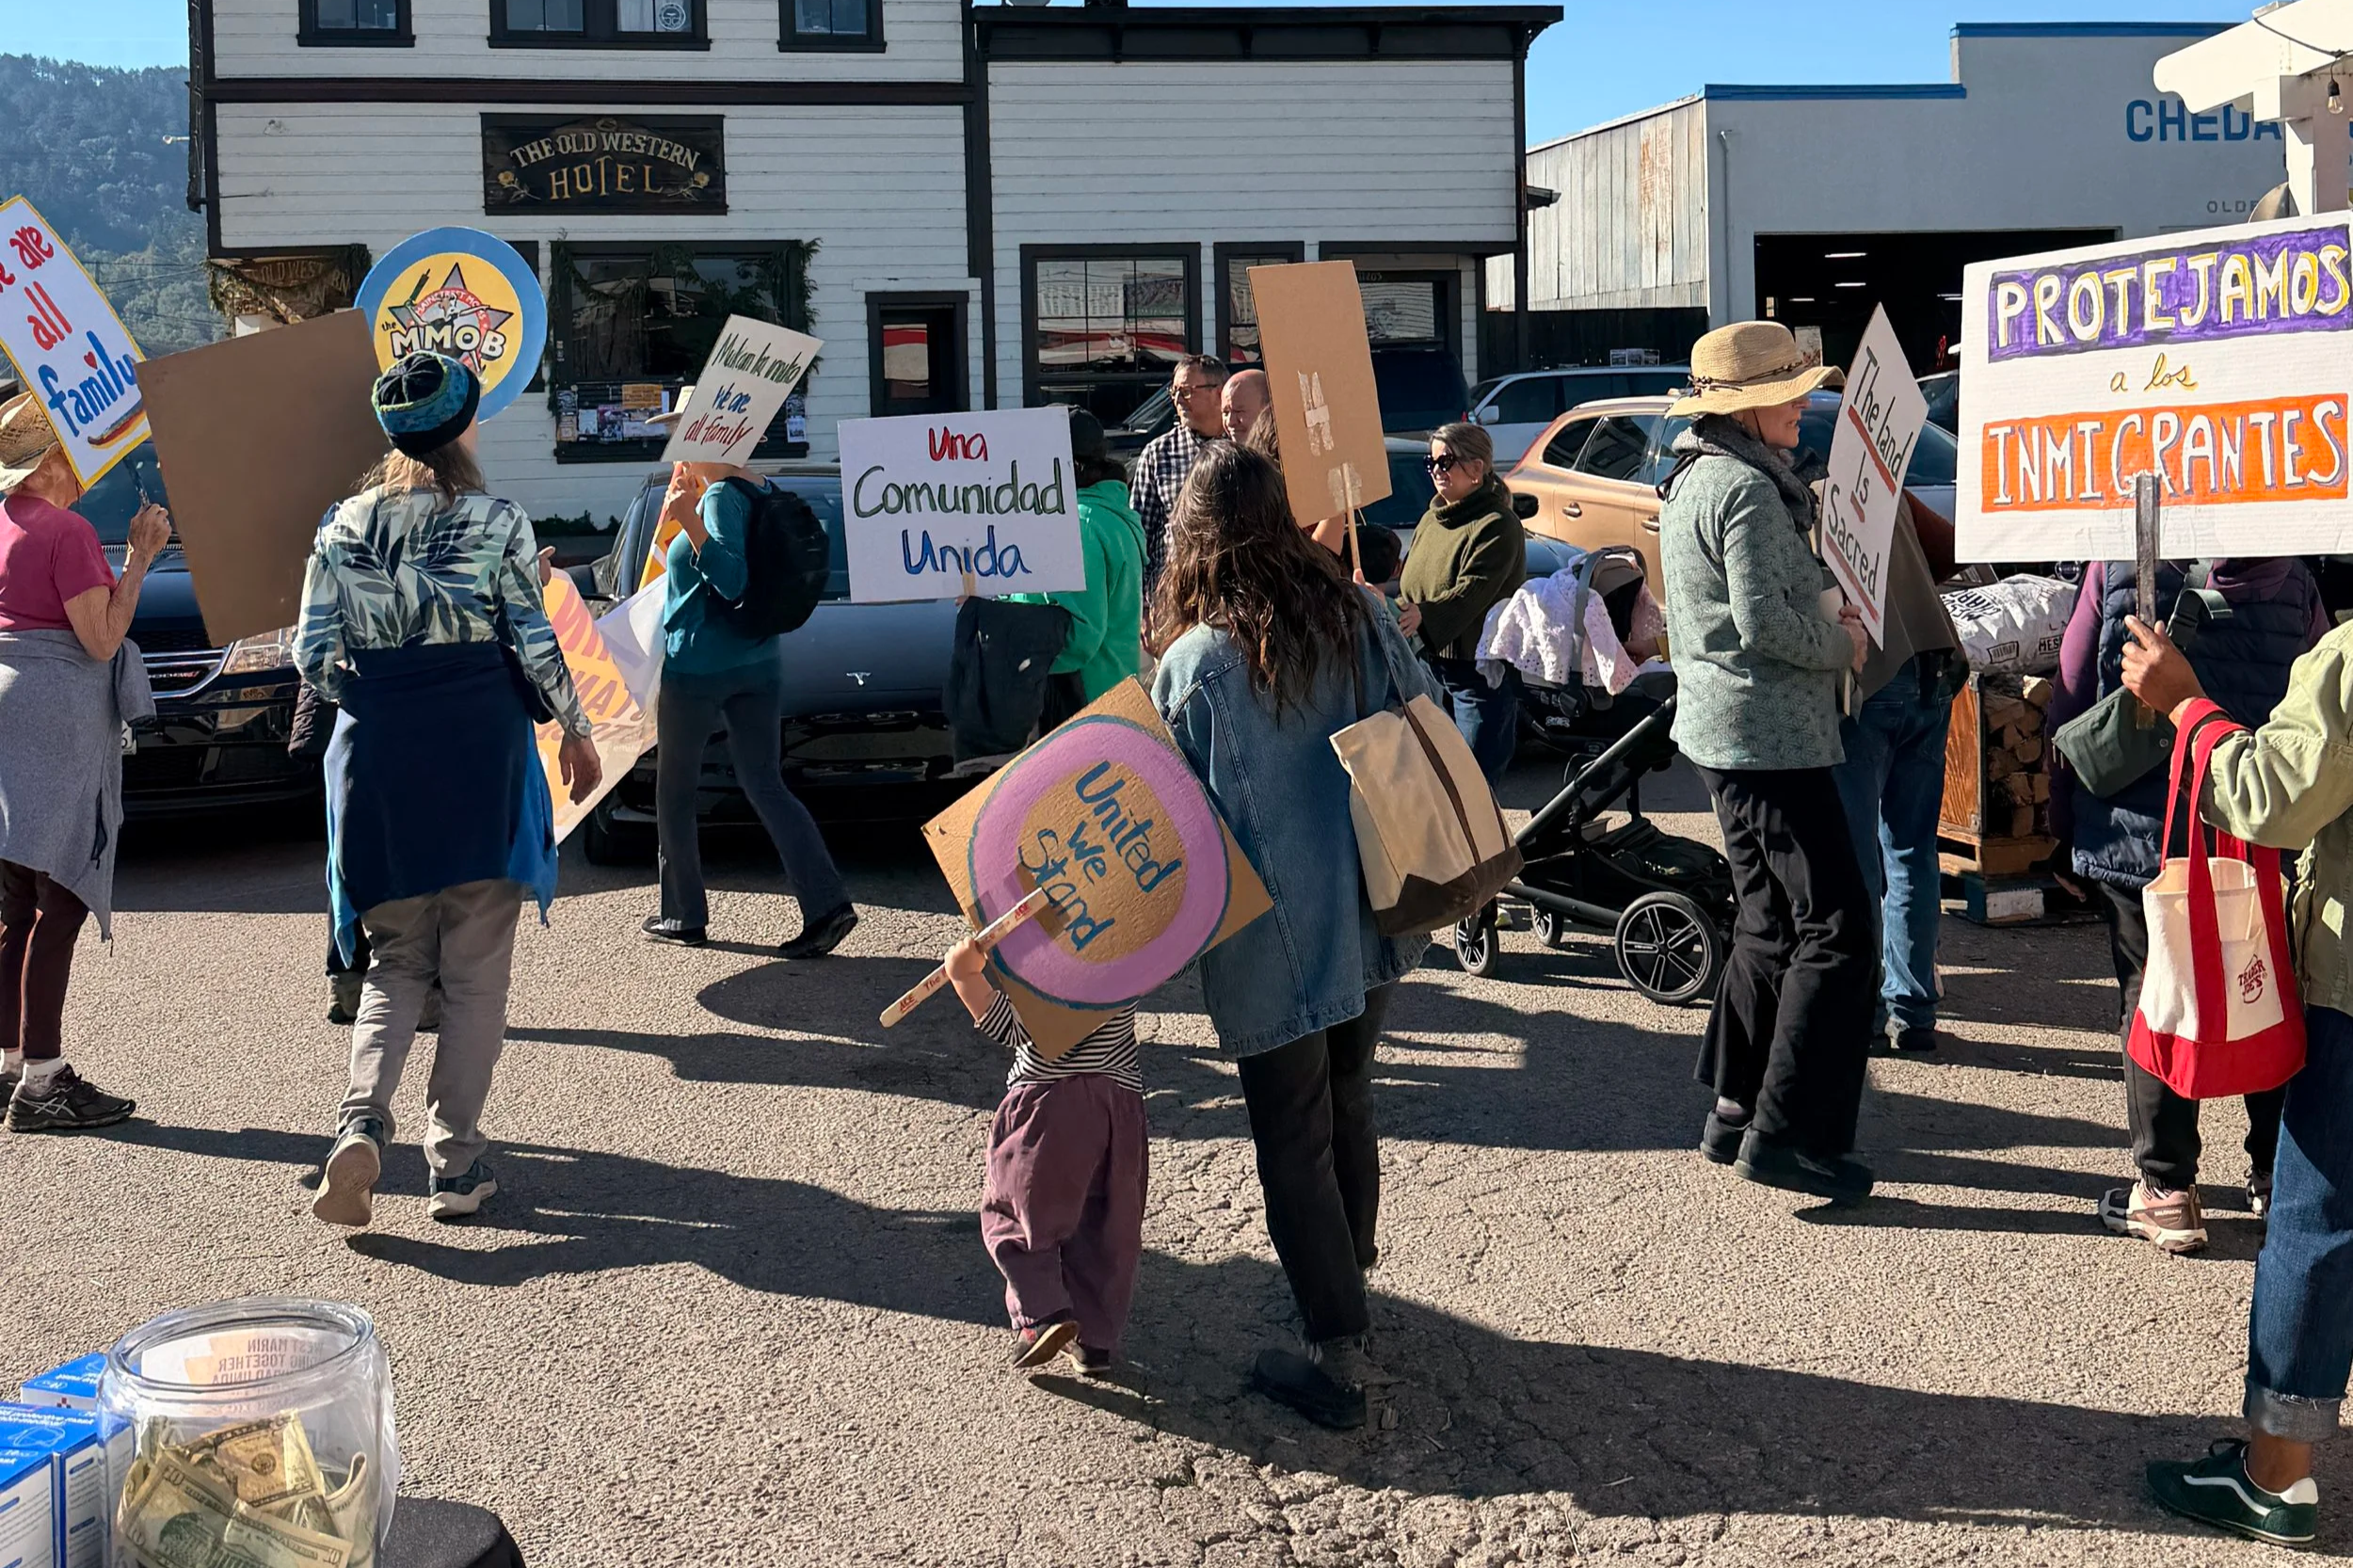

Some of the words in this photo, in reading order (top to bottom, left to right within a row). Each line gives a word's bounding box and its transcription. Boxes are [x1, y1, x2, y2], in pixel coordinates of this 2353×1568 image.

[509, 137, 556, 168] THE
[558, 132, 597, 154] OLD
[600, 131, 701, 171] WESTERN
[549, 155, 664, 200] HOTEL
[9, 225, 55, 270] are
[26, 280, 72, 351] all
[1996, 245, 2350, 348] PROTEJAMOS
[381, 320, 397, 332] the
[390, 324, 507, 361] MMOB
[1853, 344, 1881, 434] The
[2109, 370, 2129, 392] a
[2142, 353, 2200, 392] los
[683, 412, 708, 443] all
[699, 415, 754, 457] family
[928, 426, 988, 462] Una
[1988, 400, 2346, 505] INMIGRANTES
[853, 456, 1066, 519] Comunidad
[902, 524, 1032, 579] Unida
[1828, 483, 1880, 601] Sacred
[1075, 760, 1183, 893] United
[1017, 828, 1116, 952] Stand
